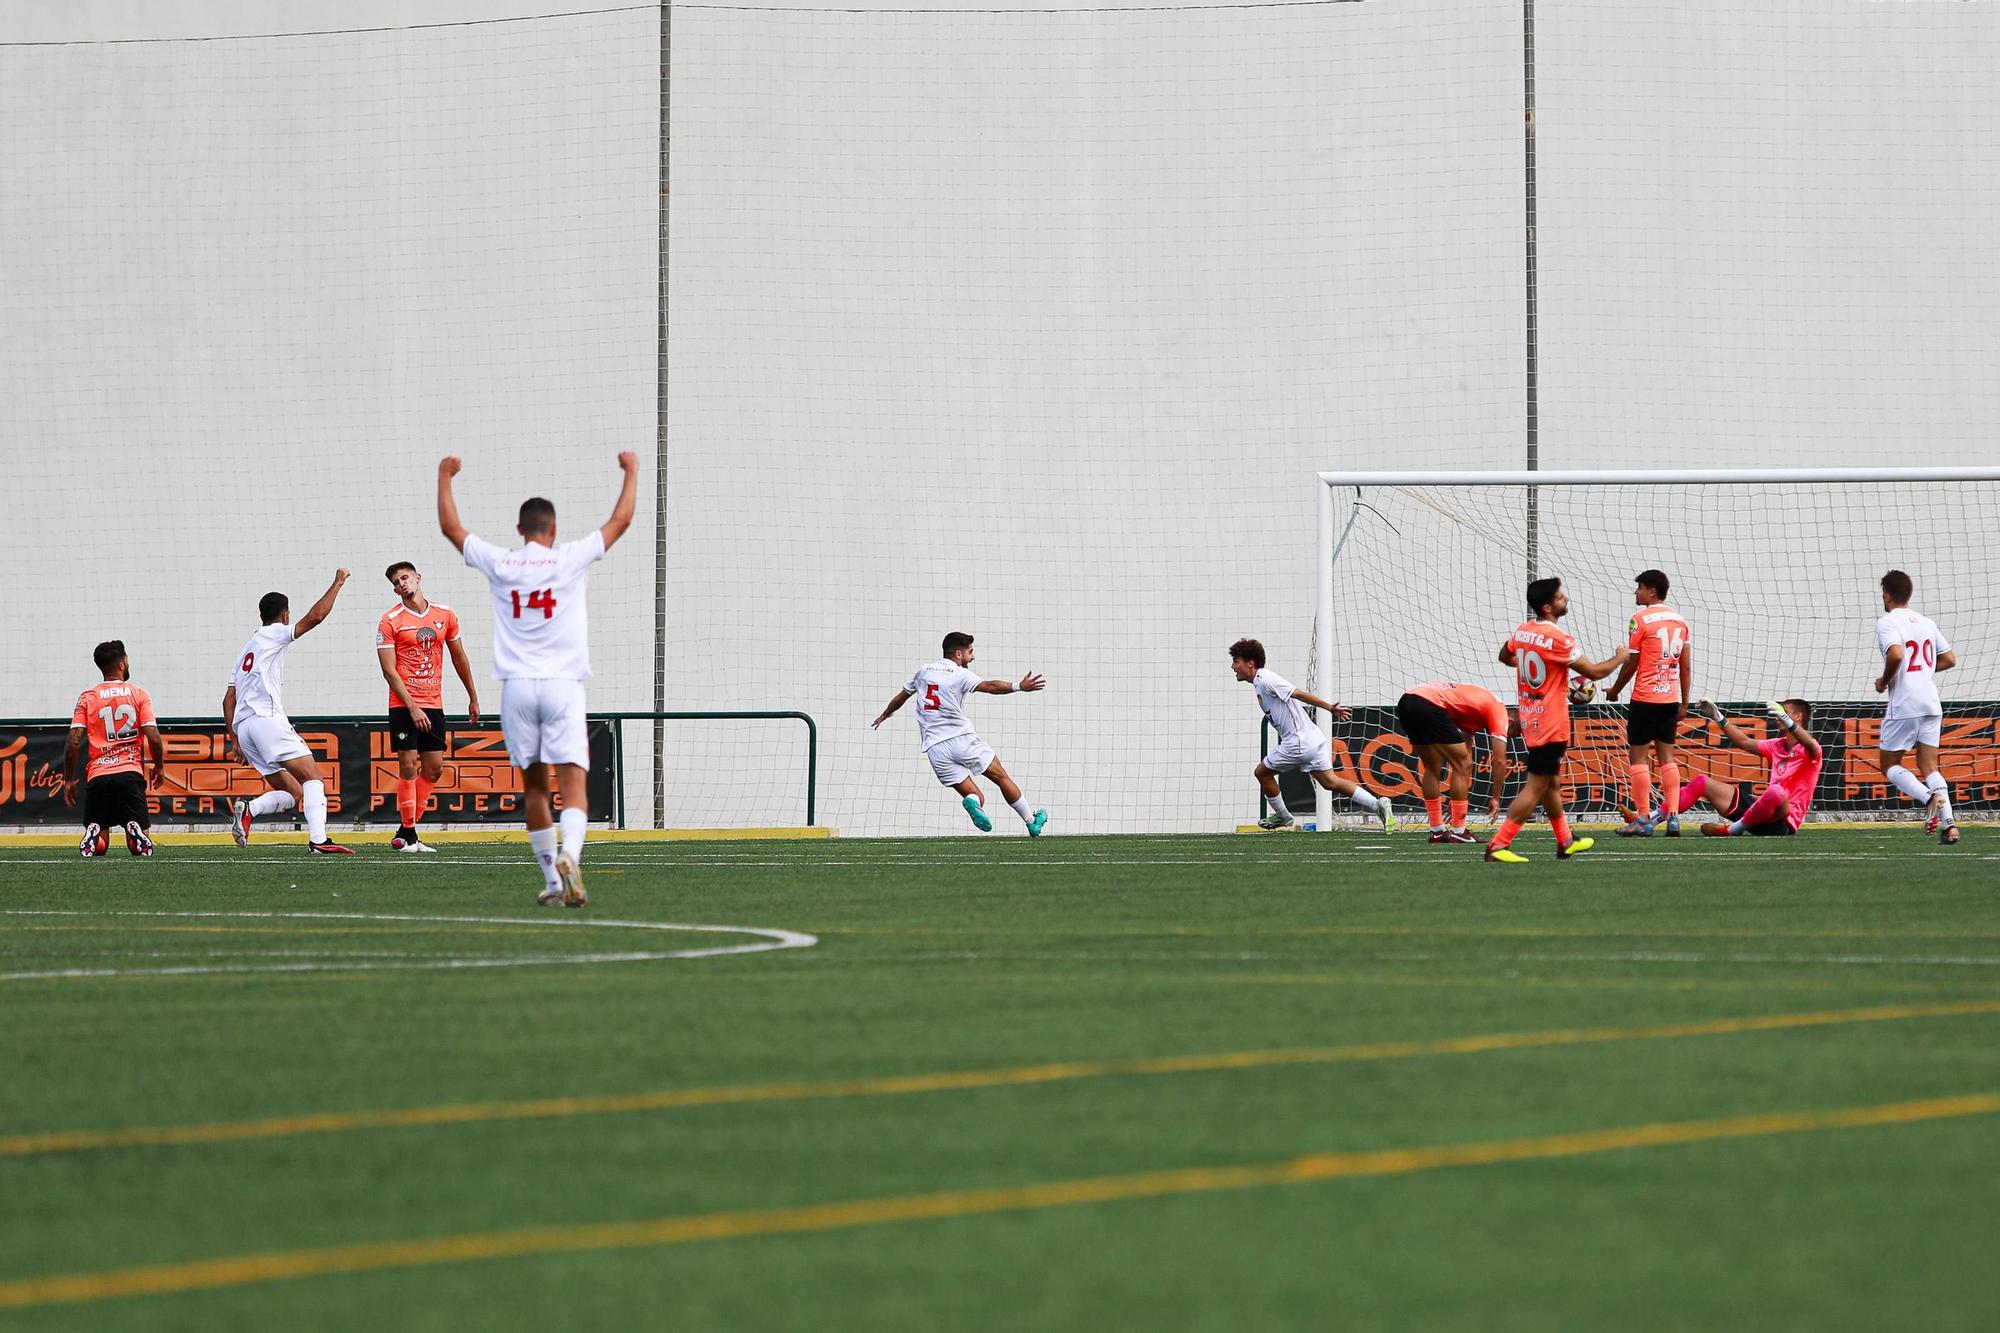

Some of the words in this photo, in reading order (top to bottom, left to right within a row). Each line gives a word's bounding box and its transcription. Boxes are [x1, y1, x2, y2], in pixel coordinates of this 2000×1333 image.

[511, 588, 557, 619] 14
[1656, 626, 1684, 660] 16
[1905, 638, 1934, 672] 20
[1516, 648, 1547, 689] 10
[100, 687, 132, 699] MENA
[923, 684, 942, 711] 5
[98, 703, 139, 742] 12
[30, 763, 66, 797] ibiz
